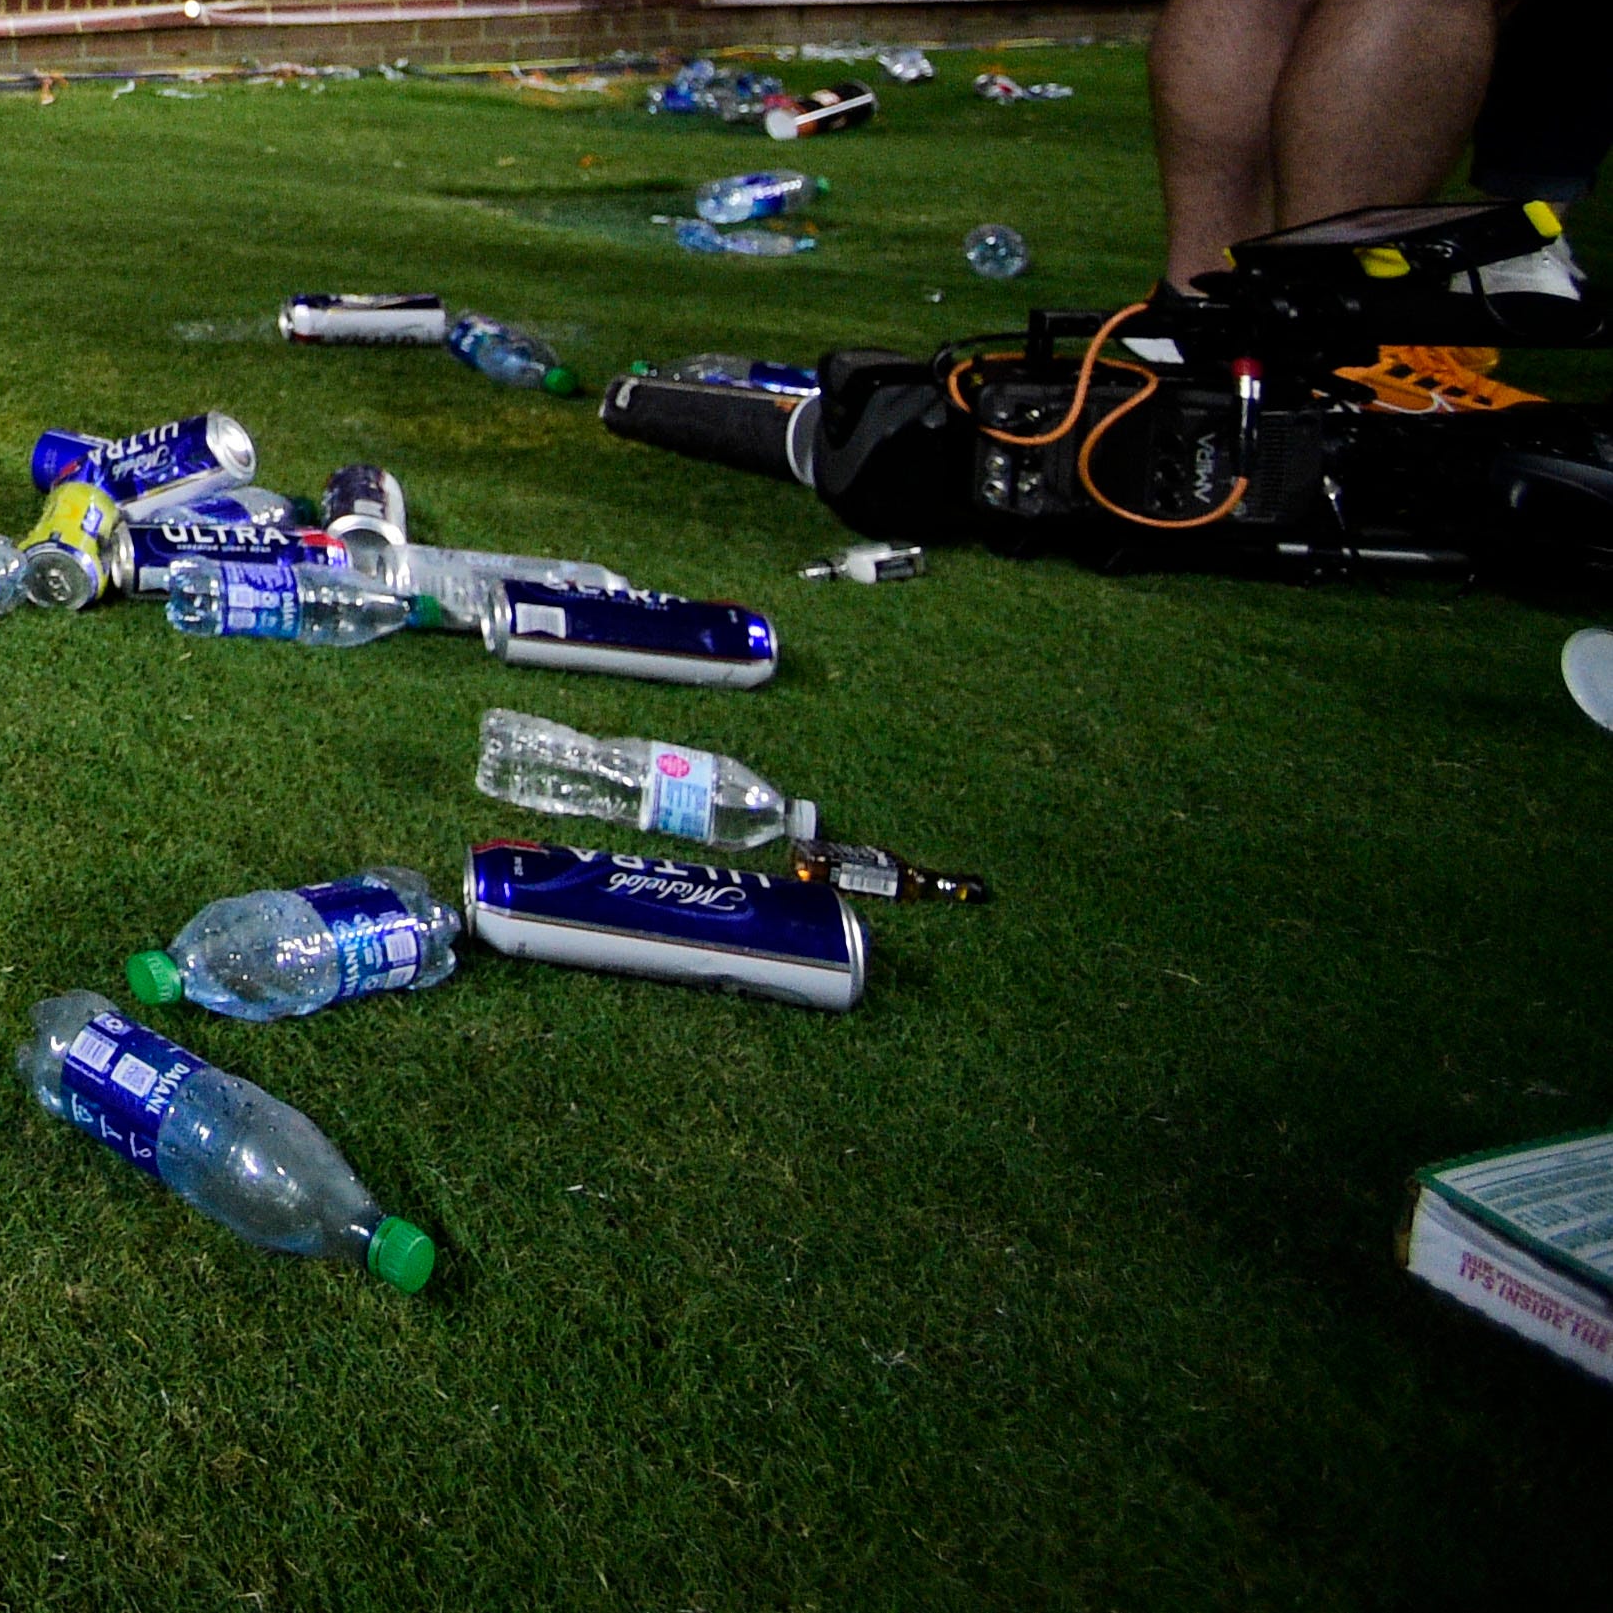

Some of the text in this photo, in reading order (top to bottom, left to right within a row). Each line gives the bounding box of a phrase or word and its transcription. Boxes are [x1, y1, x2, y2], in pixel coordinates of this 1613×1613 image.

[1192, 433, 1215, 505] AMIRA
[161, 523, 290, 545] ULTRA
[609, 871, 747, 910] Michelob
